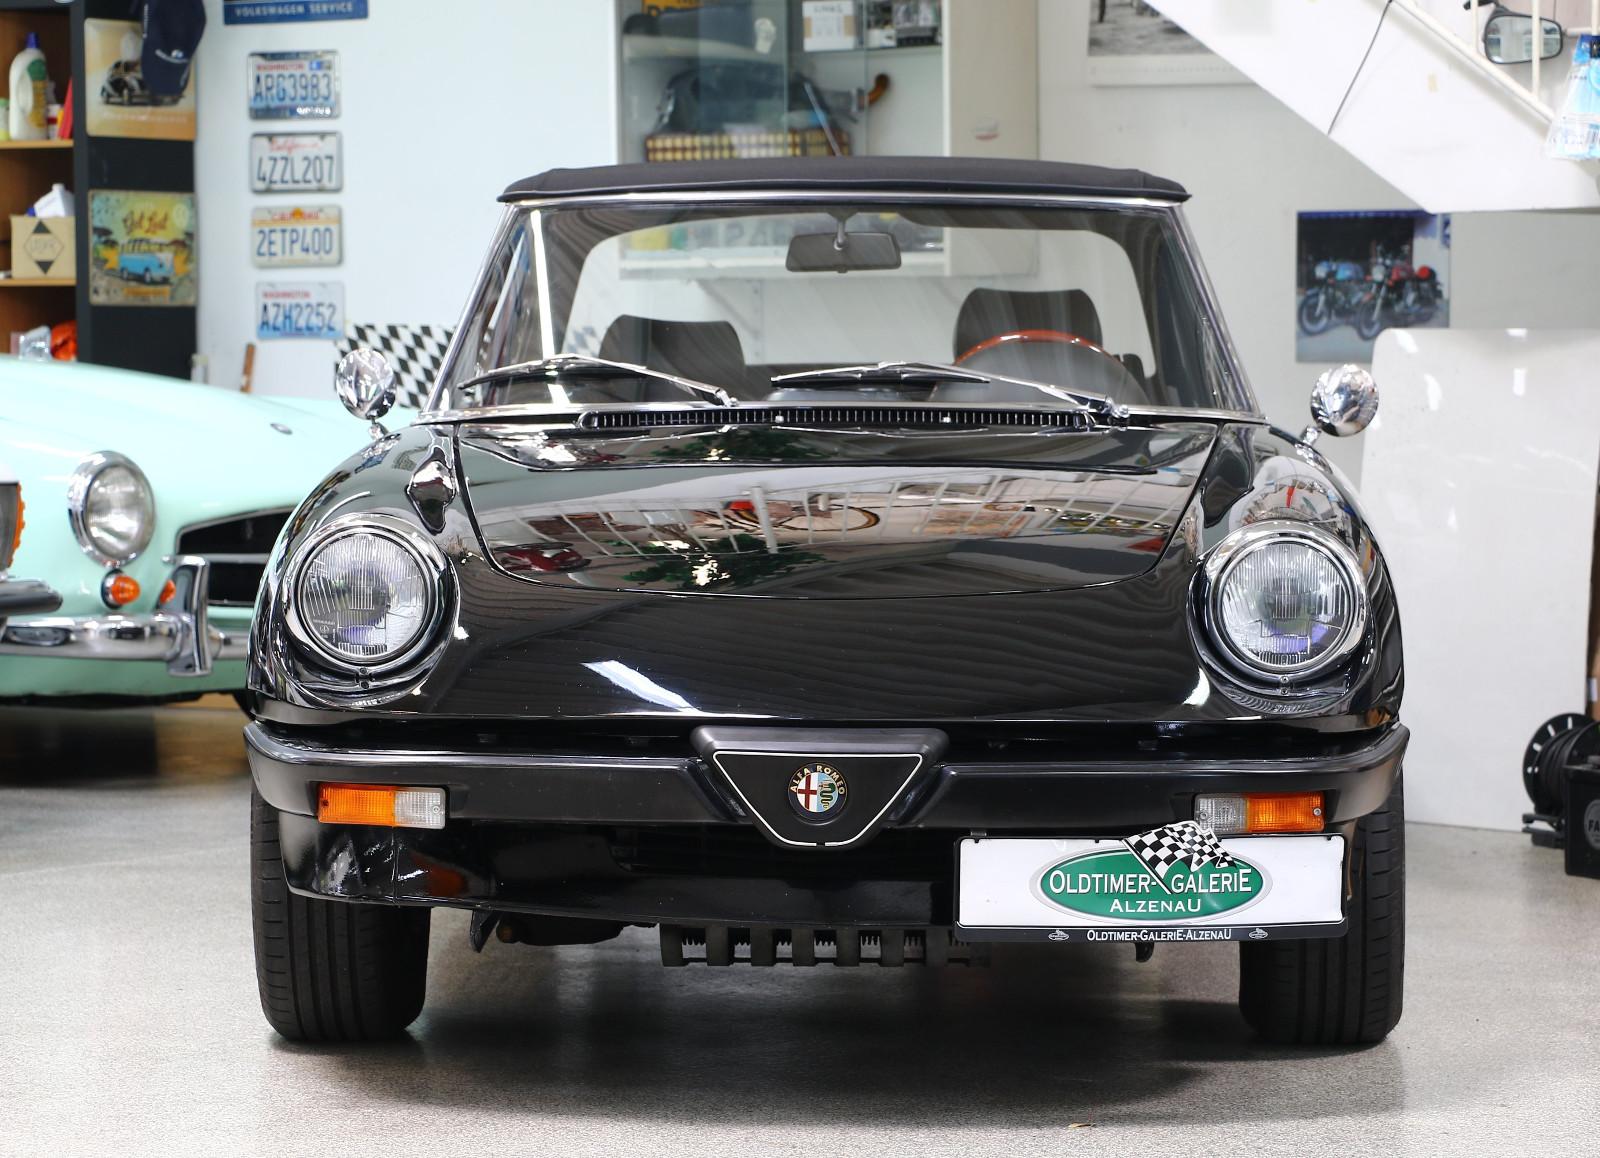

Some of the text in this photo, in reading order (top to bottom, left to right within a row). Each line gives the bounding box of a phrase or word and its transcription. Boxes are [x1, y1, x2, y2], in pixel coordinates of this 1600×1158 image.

[235, 2, 353, 17] VOLKSWAGEN SERVICE
[253, 73, 332, 103] ARG3983
[257, 155, 334, 184] 4ZZL207
[256, 227, 333, 256] 2ETP400
[261, 302, 337, 332] AZH2252
[790, 765, 845, 795] ALFA ROMEO
[1171, 868, 1252, 894] GALERIE
[1109, 898, 1202, 913] ALZENAU
